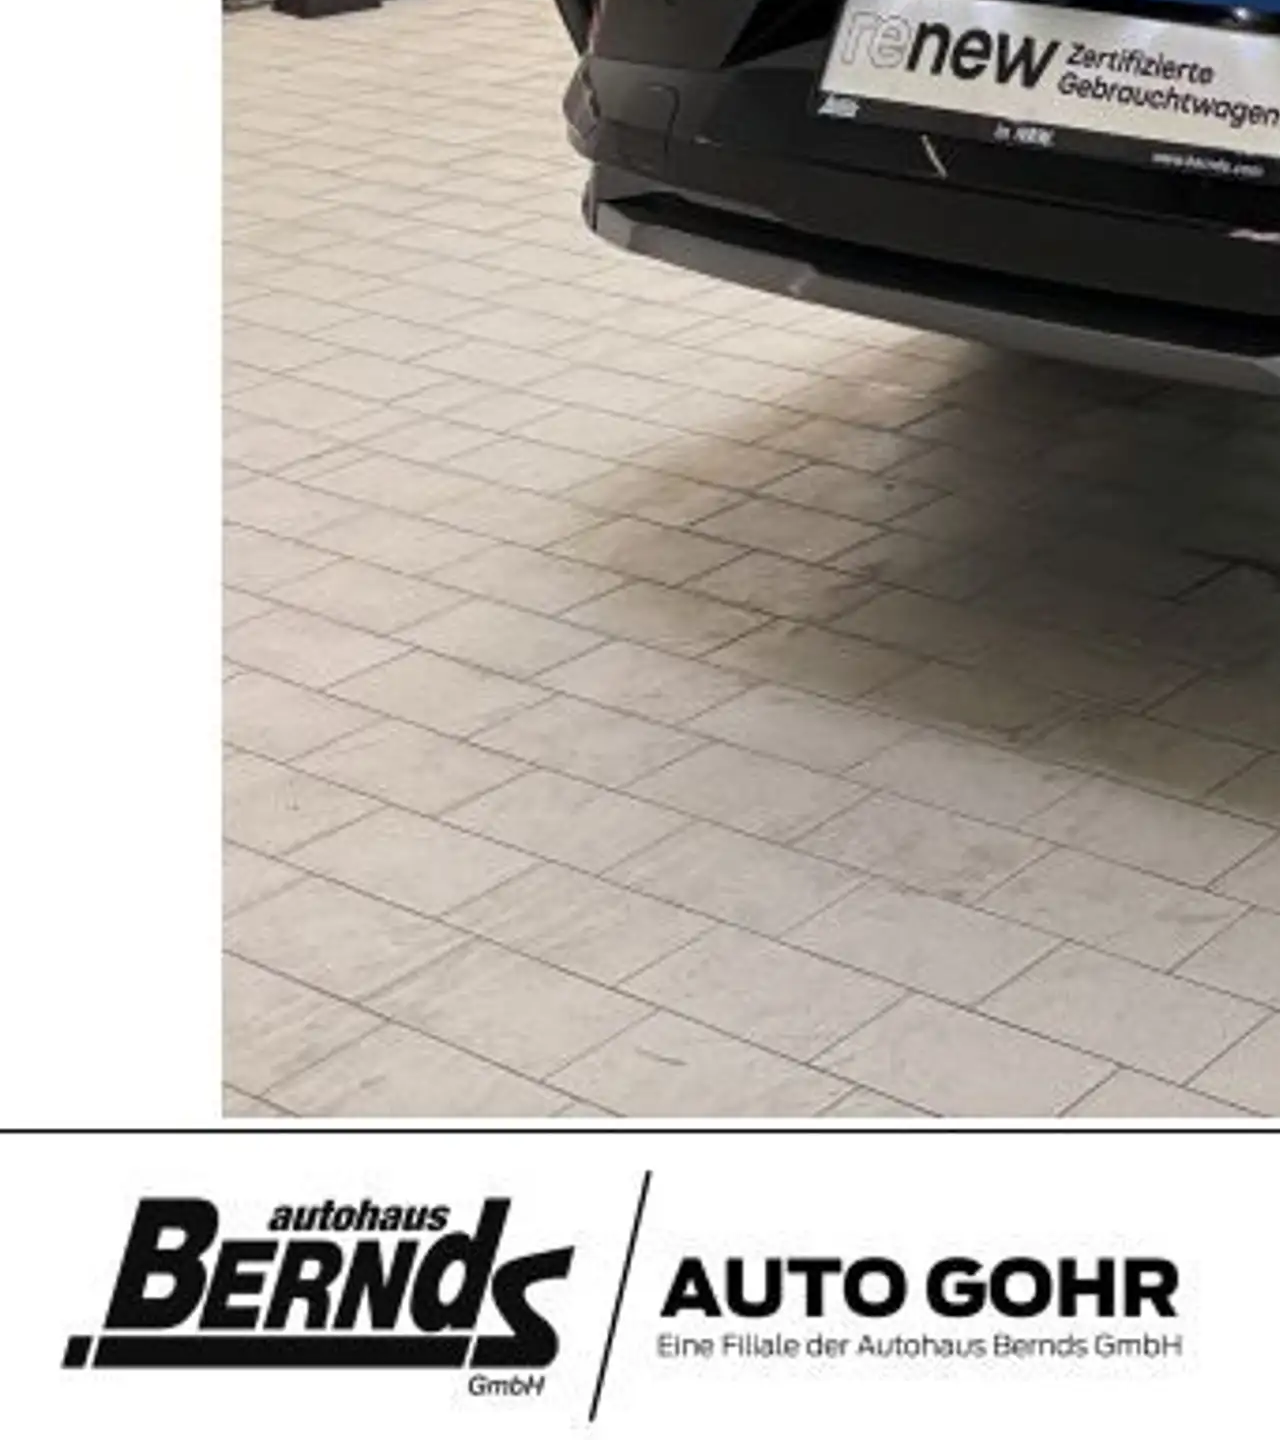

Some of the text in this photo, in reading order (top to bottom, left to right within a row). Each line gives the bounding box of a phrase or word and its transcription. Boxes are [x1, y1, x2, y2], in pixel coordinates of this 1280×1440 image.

[841, 11, 1062, 88] renew
[1066, 42, 1216, 84] Zertifizierte
[1058, 72, 1280, 129] Gebrauchtwagen
